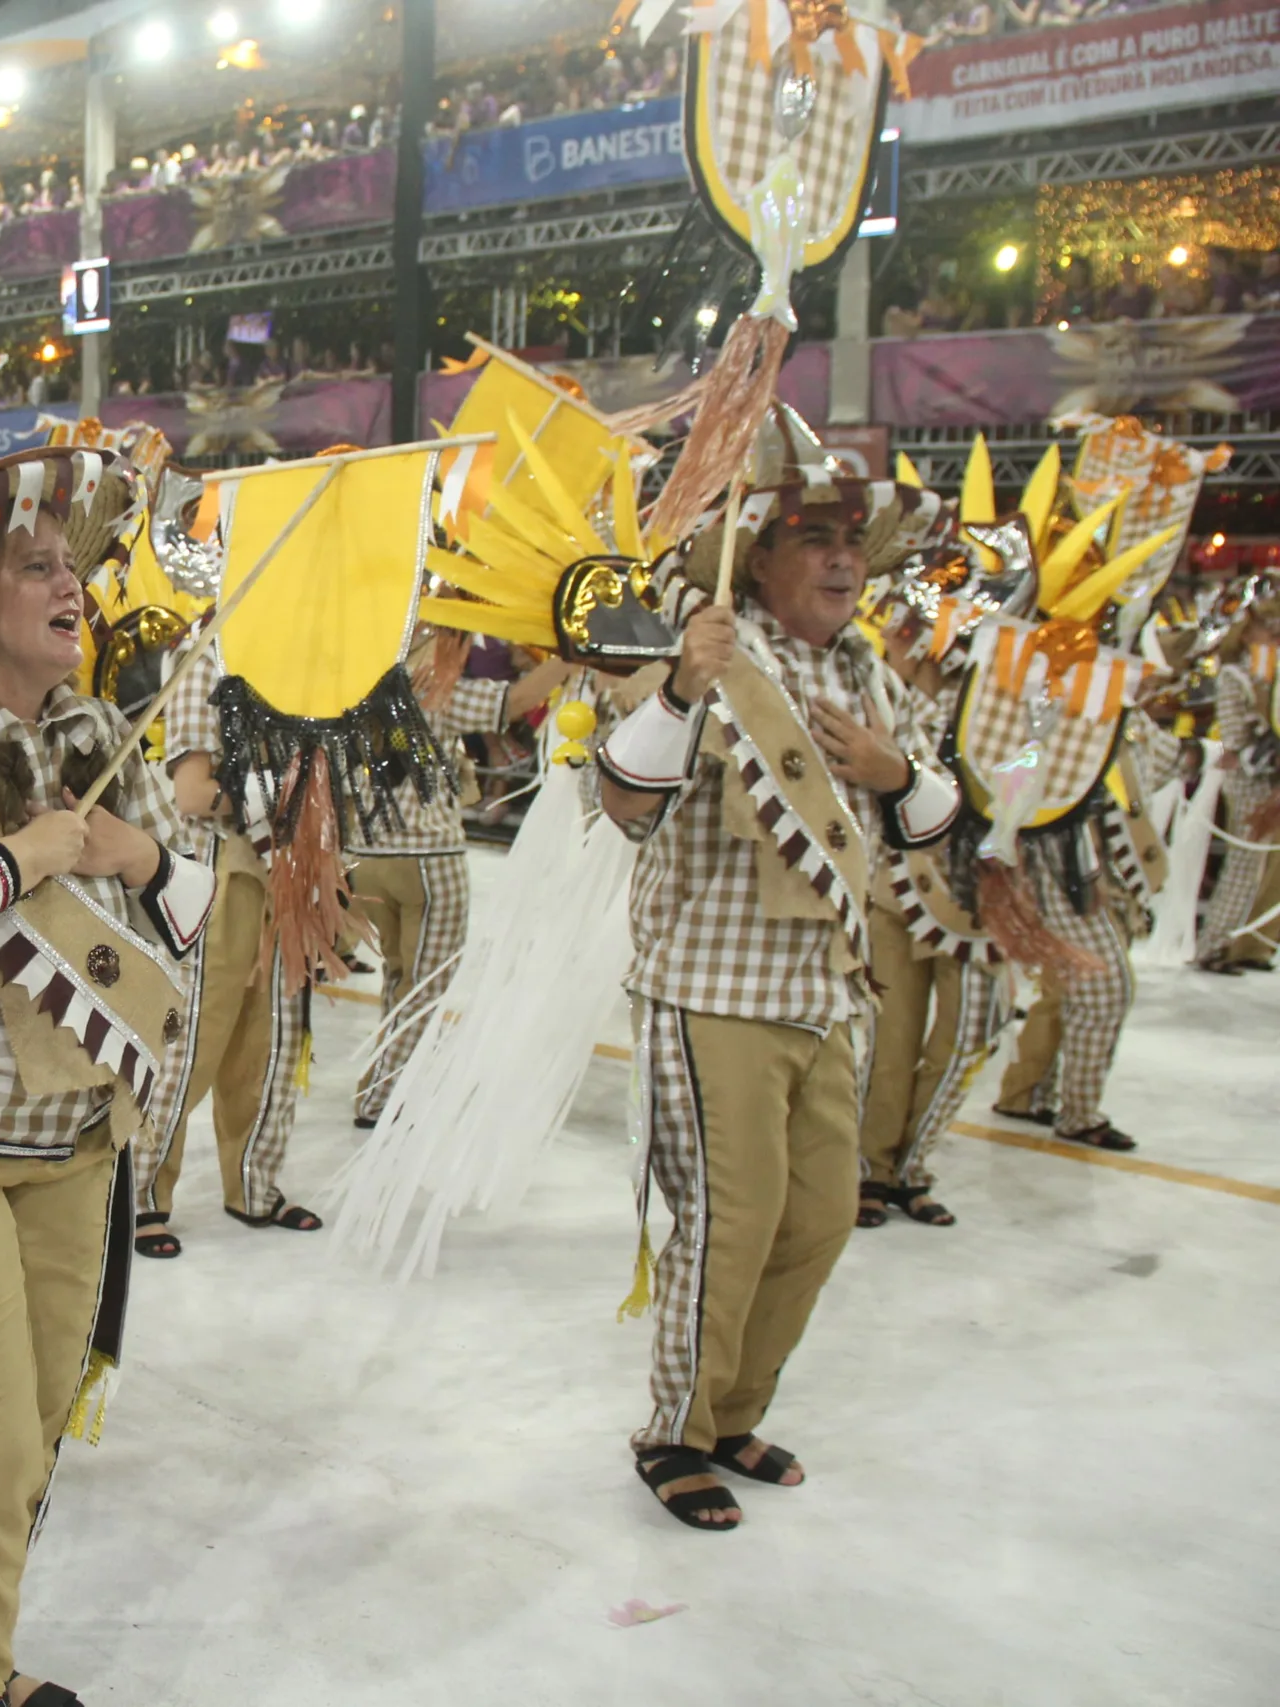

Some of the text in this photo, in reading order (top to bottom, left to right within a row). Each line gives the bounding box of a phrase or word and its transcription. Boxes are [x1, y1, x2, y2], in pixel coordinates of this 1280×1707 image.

[952, 52, 1051, 87] CARNAVAL
[1072, 38, 1119, 67] COM
[1123, 34, 1137, 58] A
[1141, 22, 1199, 56] PURO
